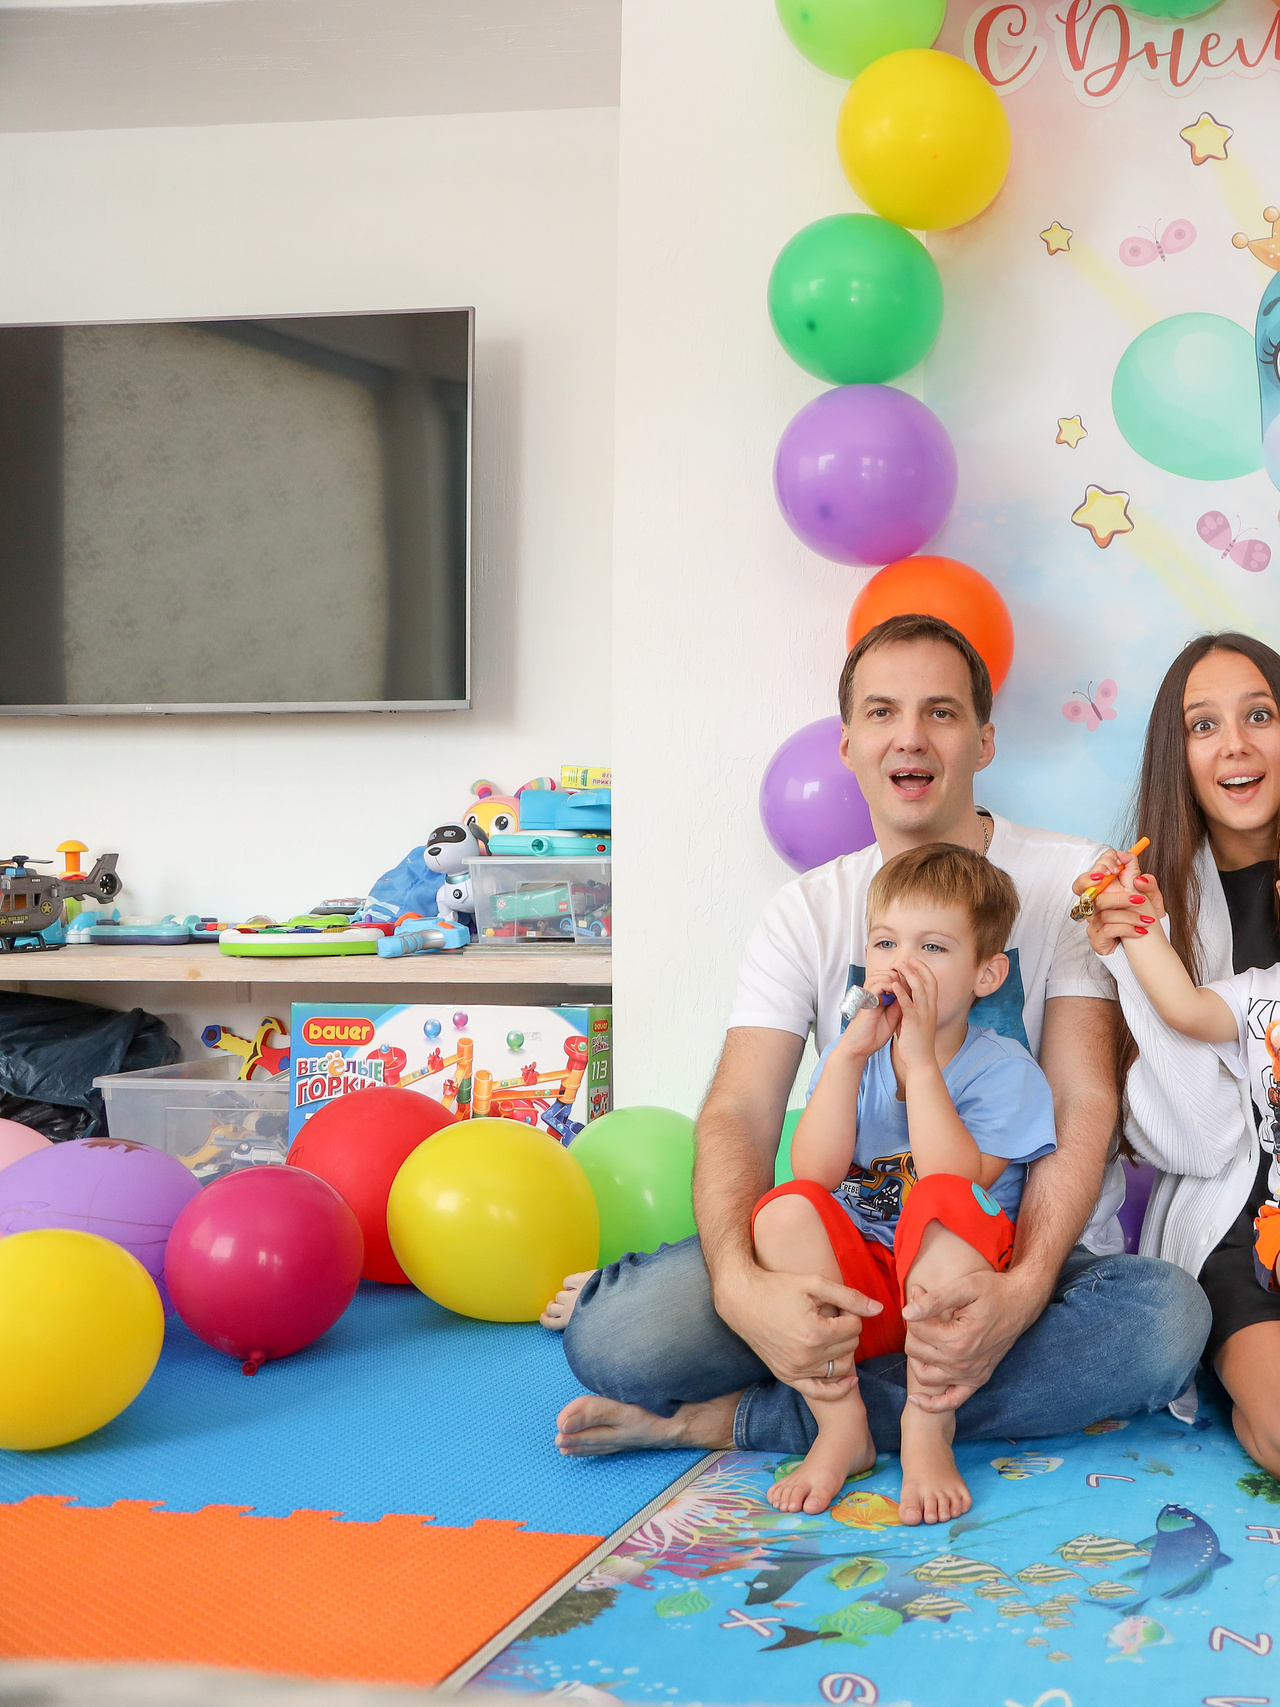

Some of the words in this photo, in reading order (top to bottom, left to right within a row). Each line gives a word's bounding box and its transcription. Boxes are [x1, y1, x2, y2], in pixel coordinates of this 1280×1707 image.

[973, 3, 1038, 87] С
[308, 1022, 371, 1041] bauer
[592, 1060, 608, 1080] 113
